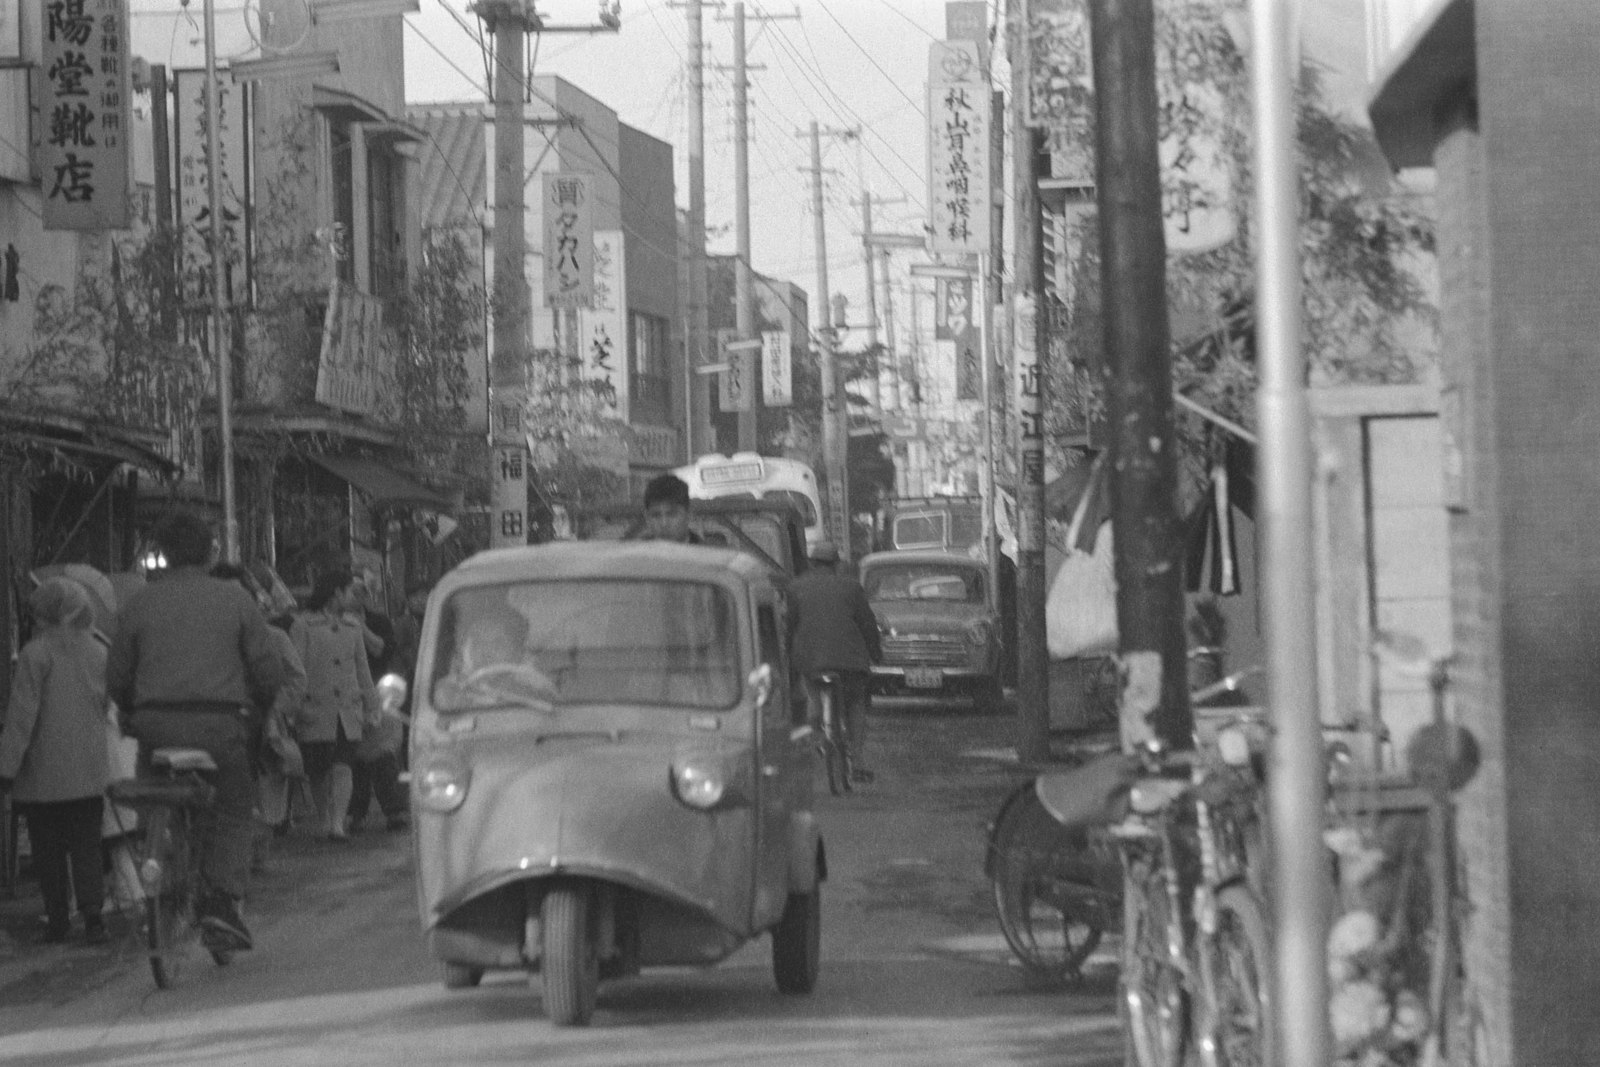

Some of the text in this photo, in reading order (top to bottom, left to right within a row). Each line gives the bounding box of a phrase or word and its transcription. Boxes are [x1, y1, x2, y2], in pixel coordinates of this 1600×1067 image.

[48, 0, 95, 203] 陽堂靴店
[945, 87, 973, 244] 秋山耳鼻咽喉科
[501, 449, 522, 538] 福田
